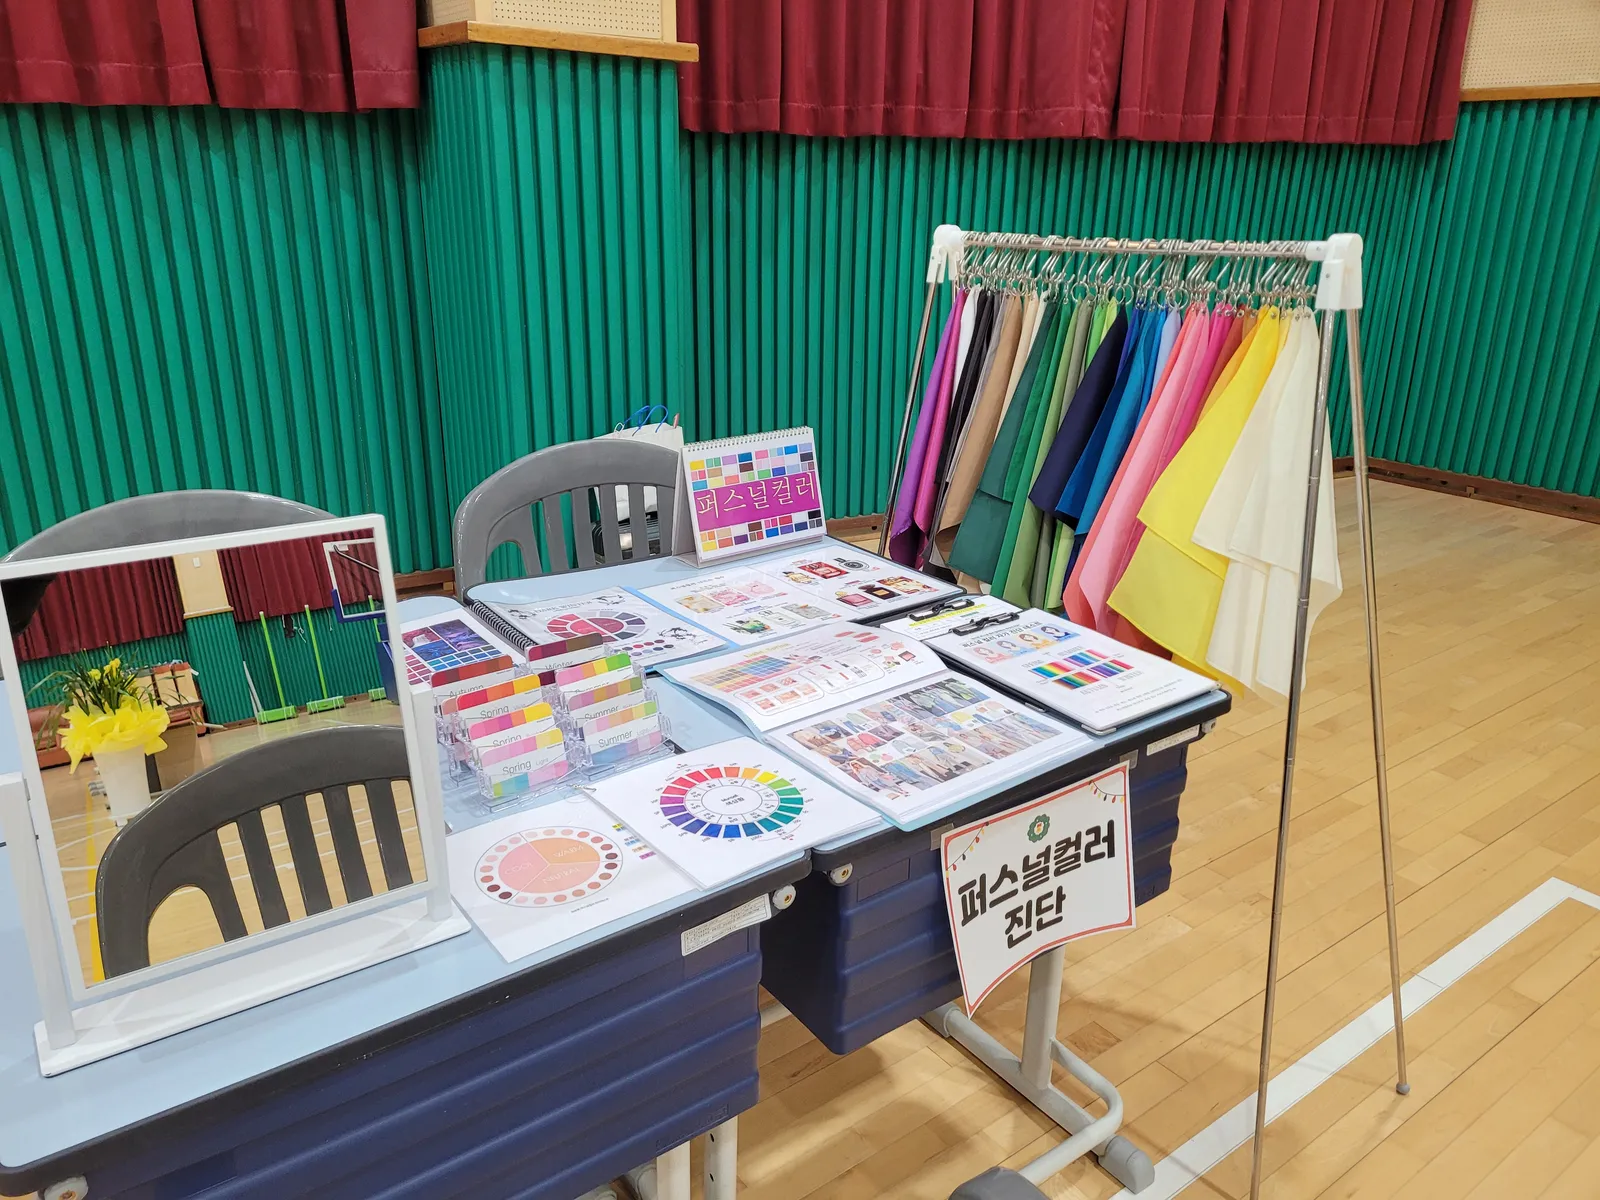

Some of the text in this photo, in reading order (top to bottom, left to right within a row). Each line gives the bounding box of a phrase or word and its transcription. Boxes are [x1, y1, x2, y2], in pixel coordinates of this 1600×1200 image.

[696, 471, 816, 519] 퍼스널컬러
[480, 705, 510, 720] Spring
[584, 705, 619, 720] Summer
[598, 729, 633, 749] Summer
[502, 759, 532, 776] Spring
[957, 819, 1116, 927] 퍼스널컬러
[1004, 884, 1067, 949] 진단
